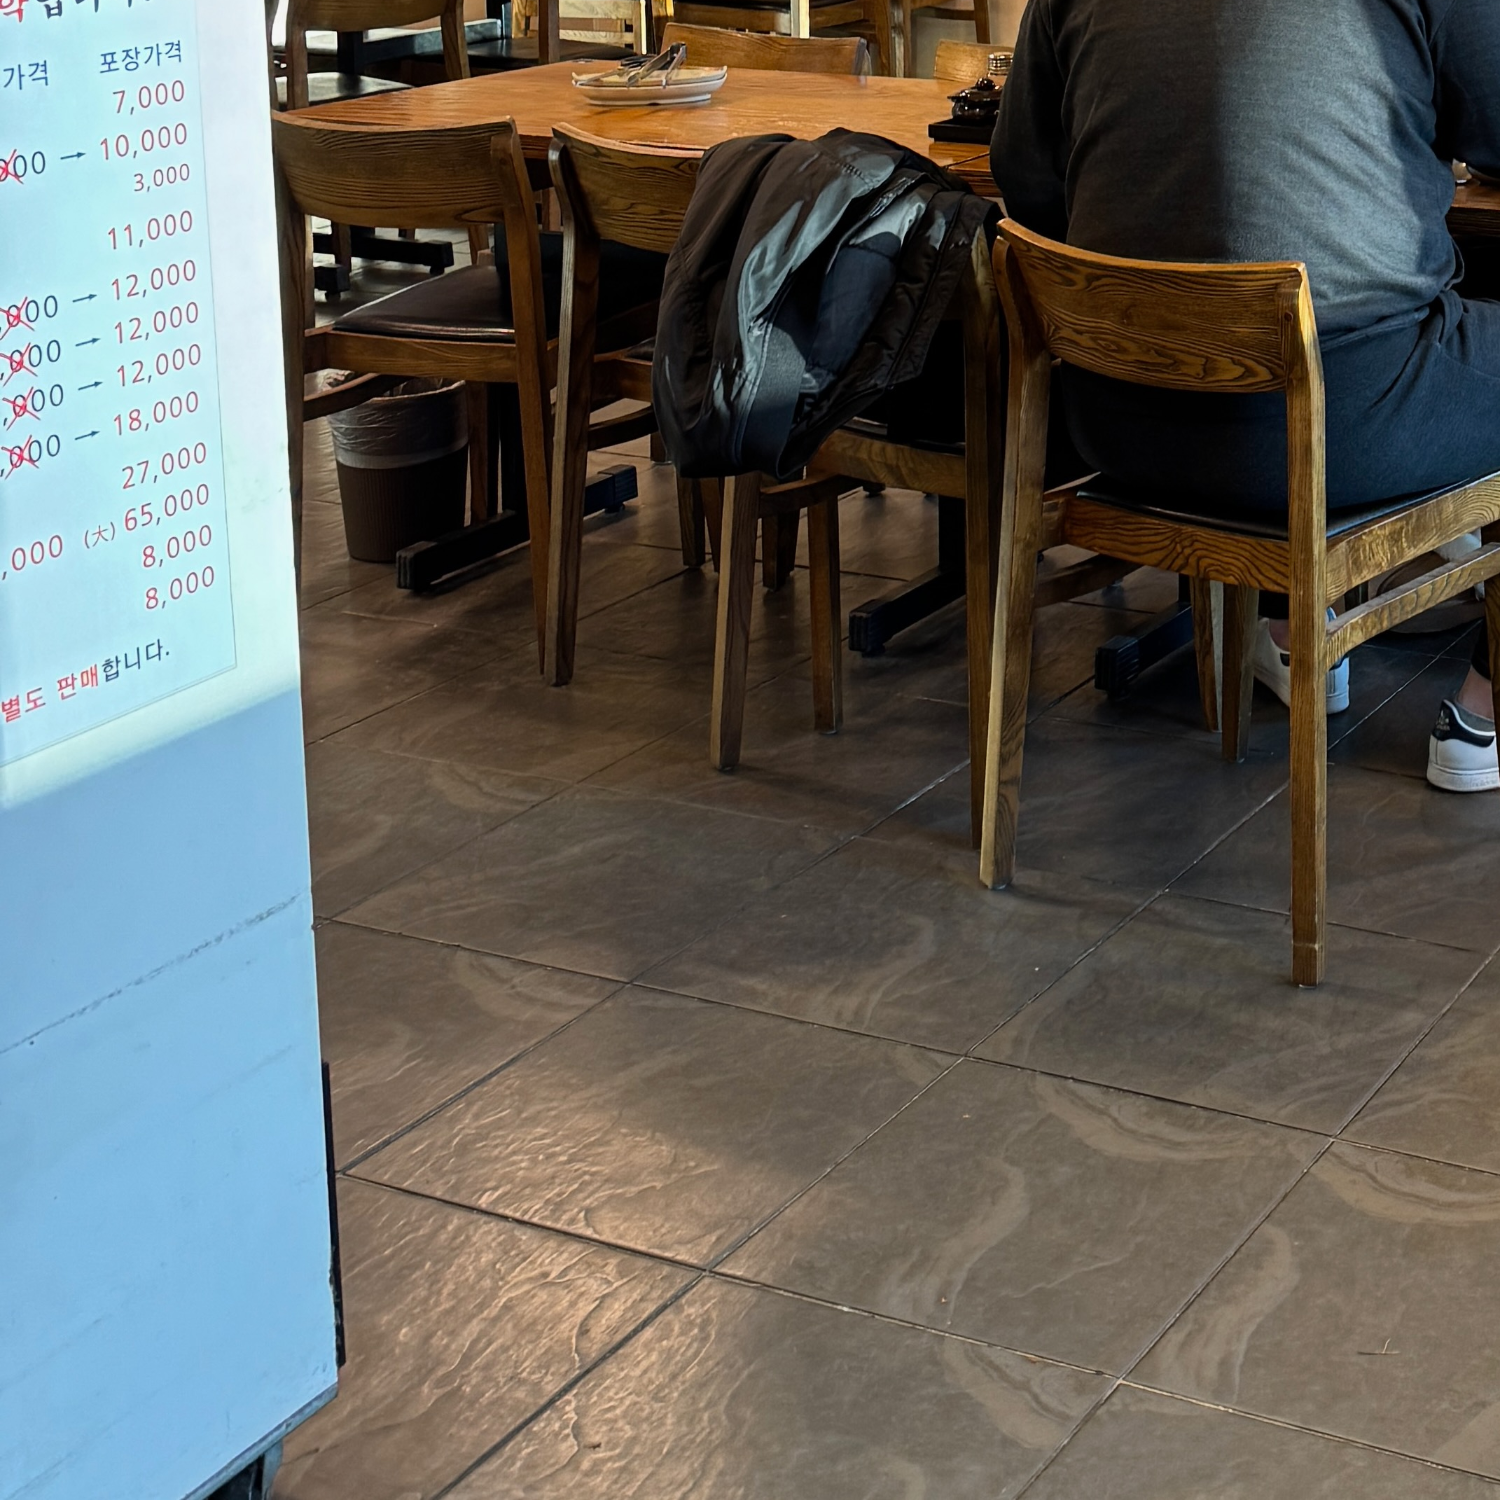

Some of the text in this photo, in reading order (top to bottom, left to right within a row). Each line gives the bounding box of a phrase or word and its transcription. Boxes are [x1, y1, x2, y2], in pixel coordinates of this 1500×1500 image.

[3, 40, 182, 90] 가격 포장가격
[112, 79, 185, 116] 7,000
[100, 122, 187, 161] 10,000
[133, 163, 190, 193] 3,000
[108, 210, 193, 250] 11,000
[111, 259, 196, 301] 12,000
[115, 302, 198, 344] 12,000
[117, 344, 200, 387] 12,000
[114, 391, 198, 436] 18,000
[121, 442, 207, 490] 27,000
[124, 483, 210, 532] 65,000
[142, 524, 212, 569] 8,000
[146, 566, 215, 610] 8,000
[1, 639, 170, 723] 별도 판매합니다.
